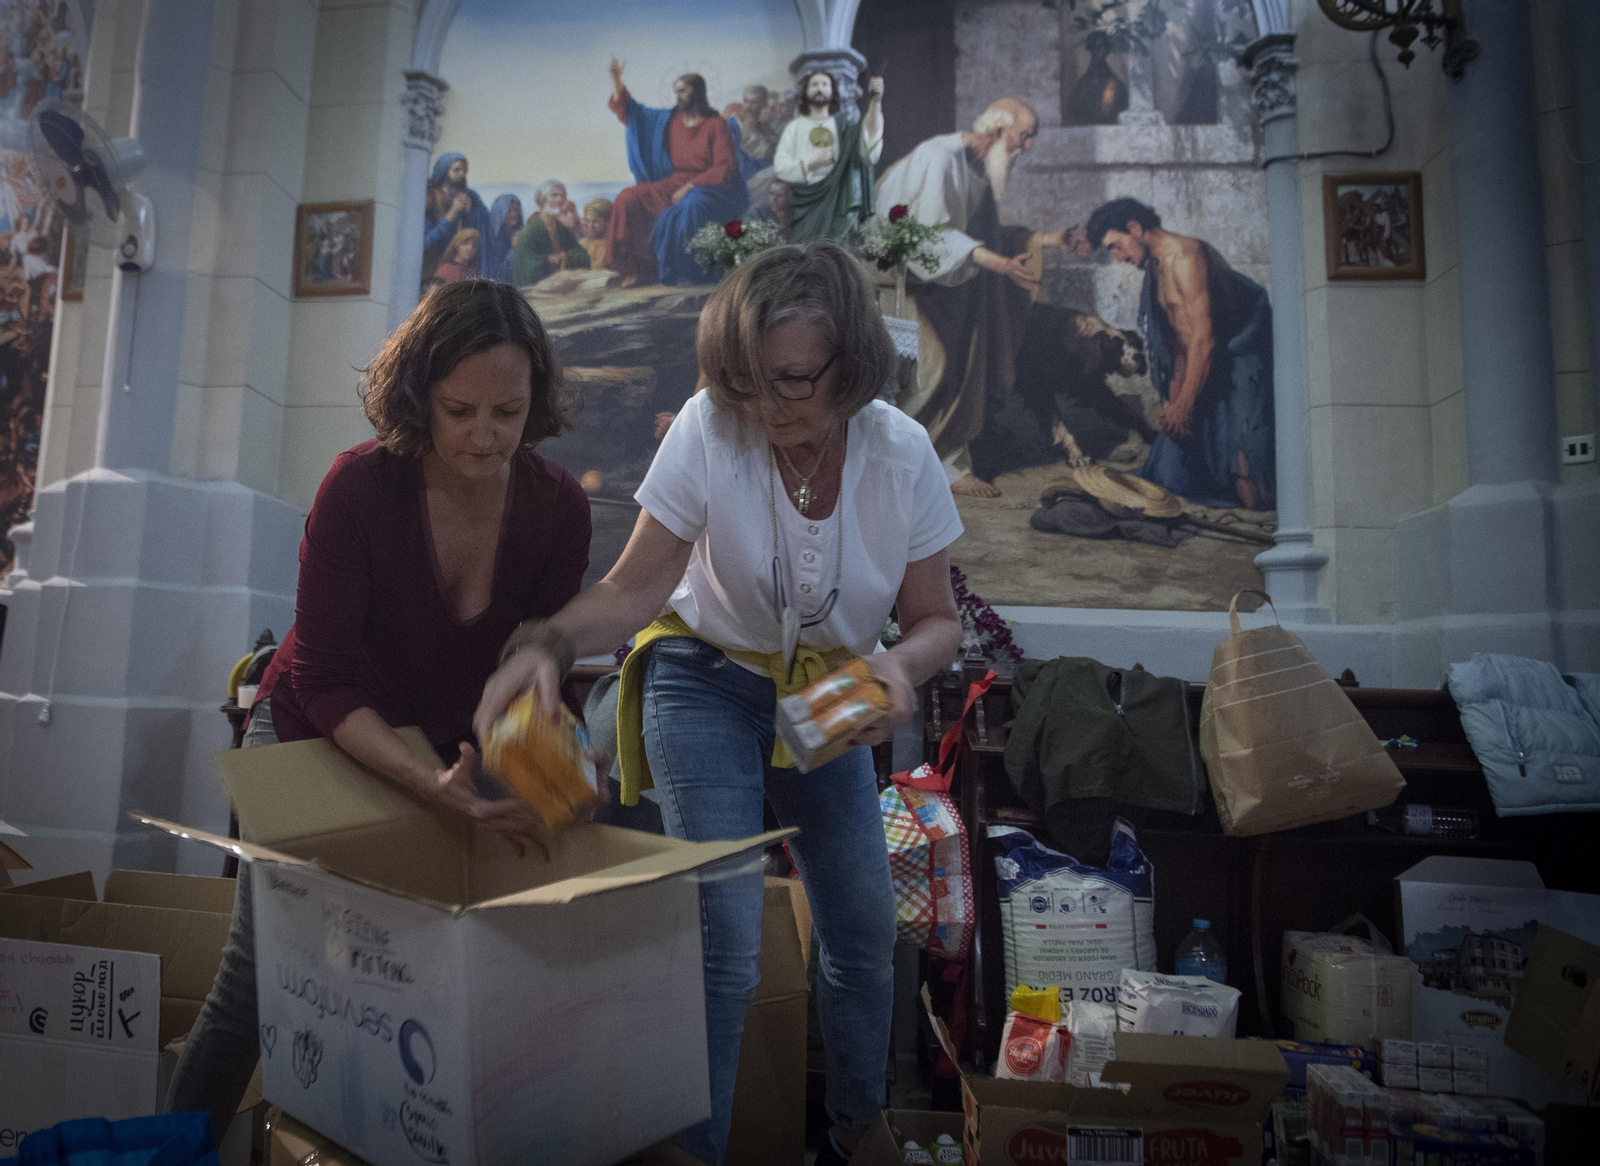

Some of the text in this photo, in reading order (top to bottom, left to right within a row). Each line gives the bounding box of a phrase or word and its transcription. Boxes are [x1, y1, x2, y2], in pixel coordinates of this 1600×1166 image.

[1038, 970, 1114, 981] GRANO MEDIO
[1080, 986, 1121, 1003] ROZ
[1181, 1001, 1218, 1018] HACENDADO
[1149, 1137, 1209, 1161] FRUTA
